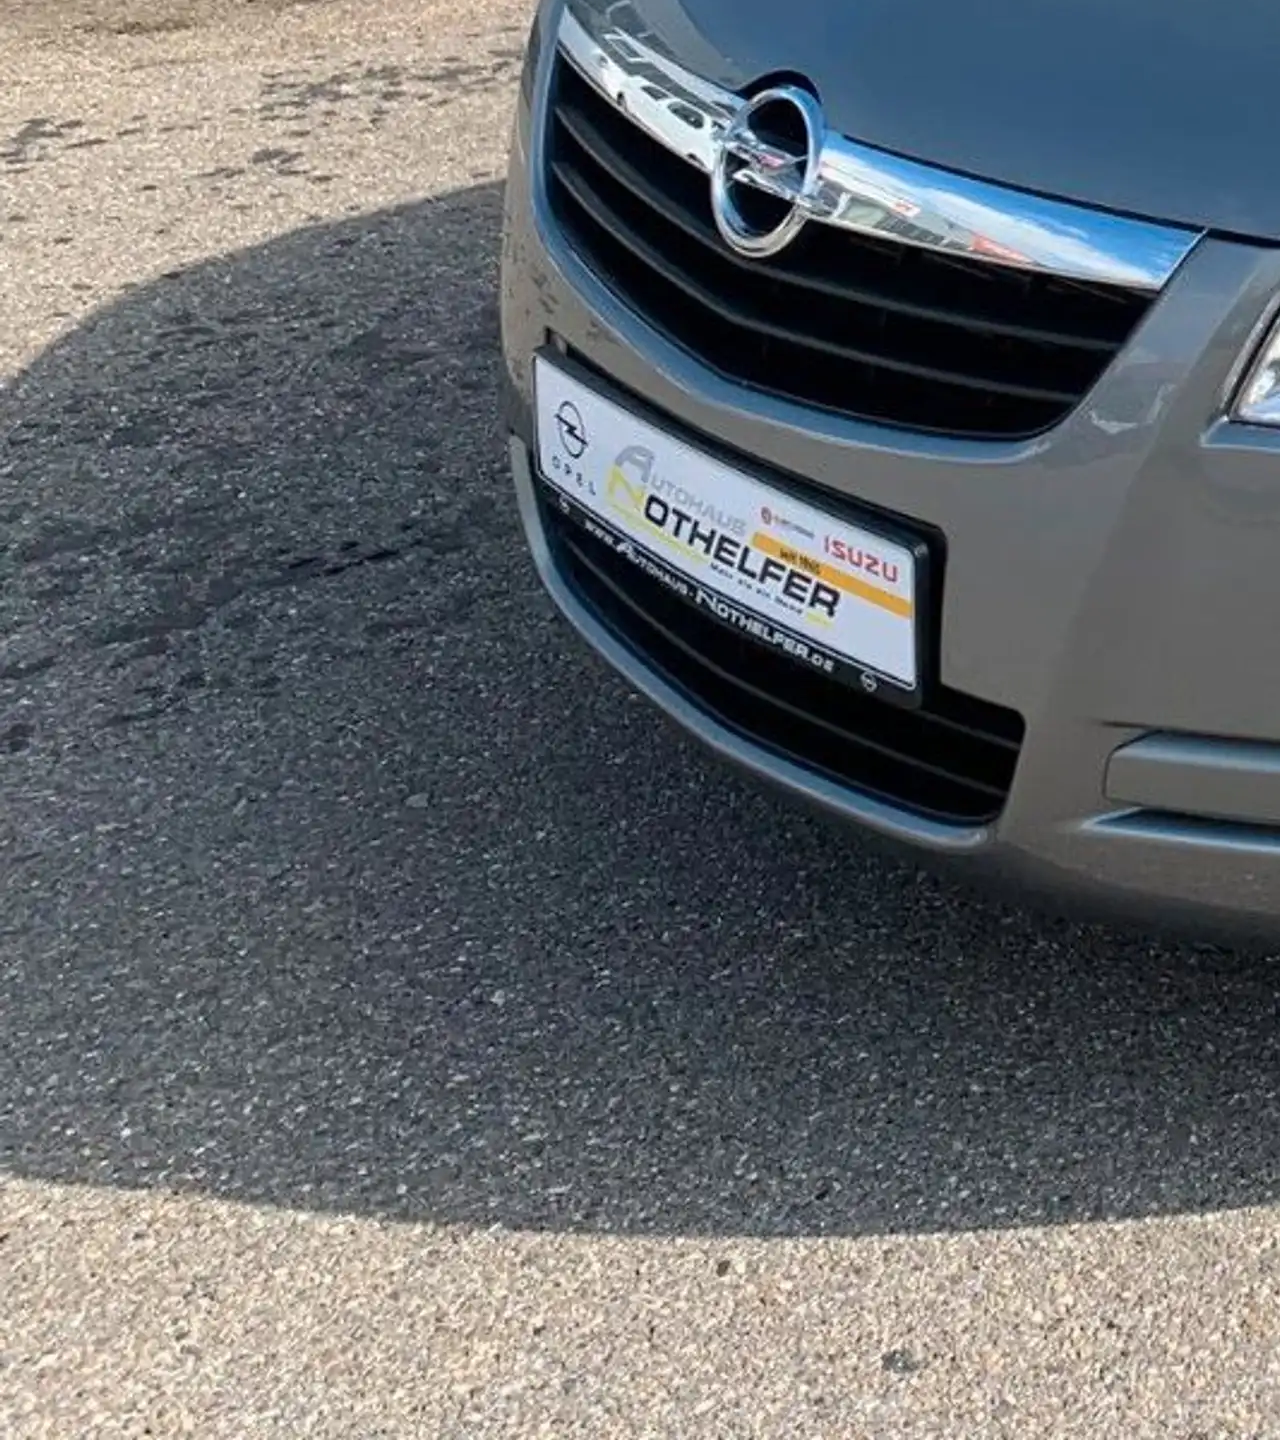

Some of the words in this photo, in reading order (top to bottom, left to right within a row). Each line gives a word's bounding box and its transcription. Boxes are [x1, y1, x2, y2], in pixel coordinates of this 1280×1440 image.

[614, 444, 748, 537] AUTOHAUS
[607, 464, 842, 619] NOTHELFER
[824, 535, 899, 583] ISUZU
